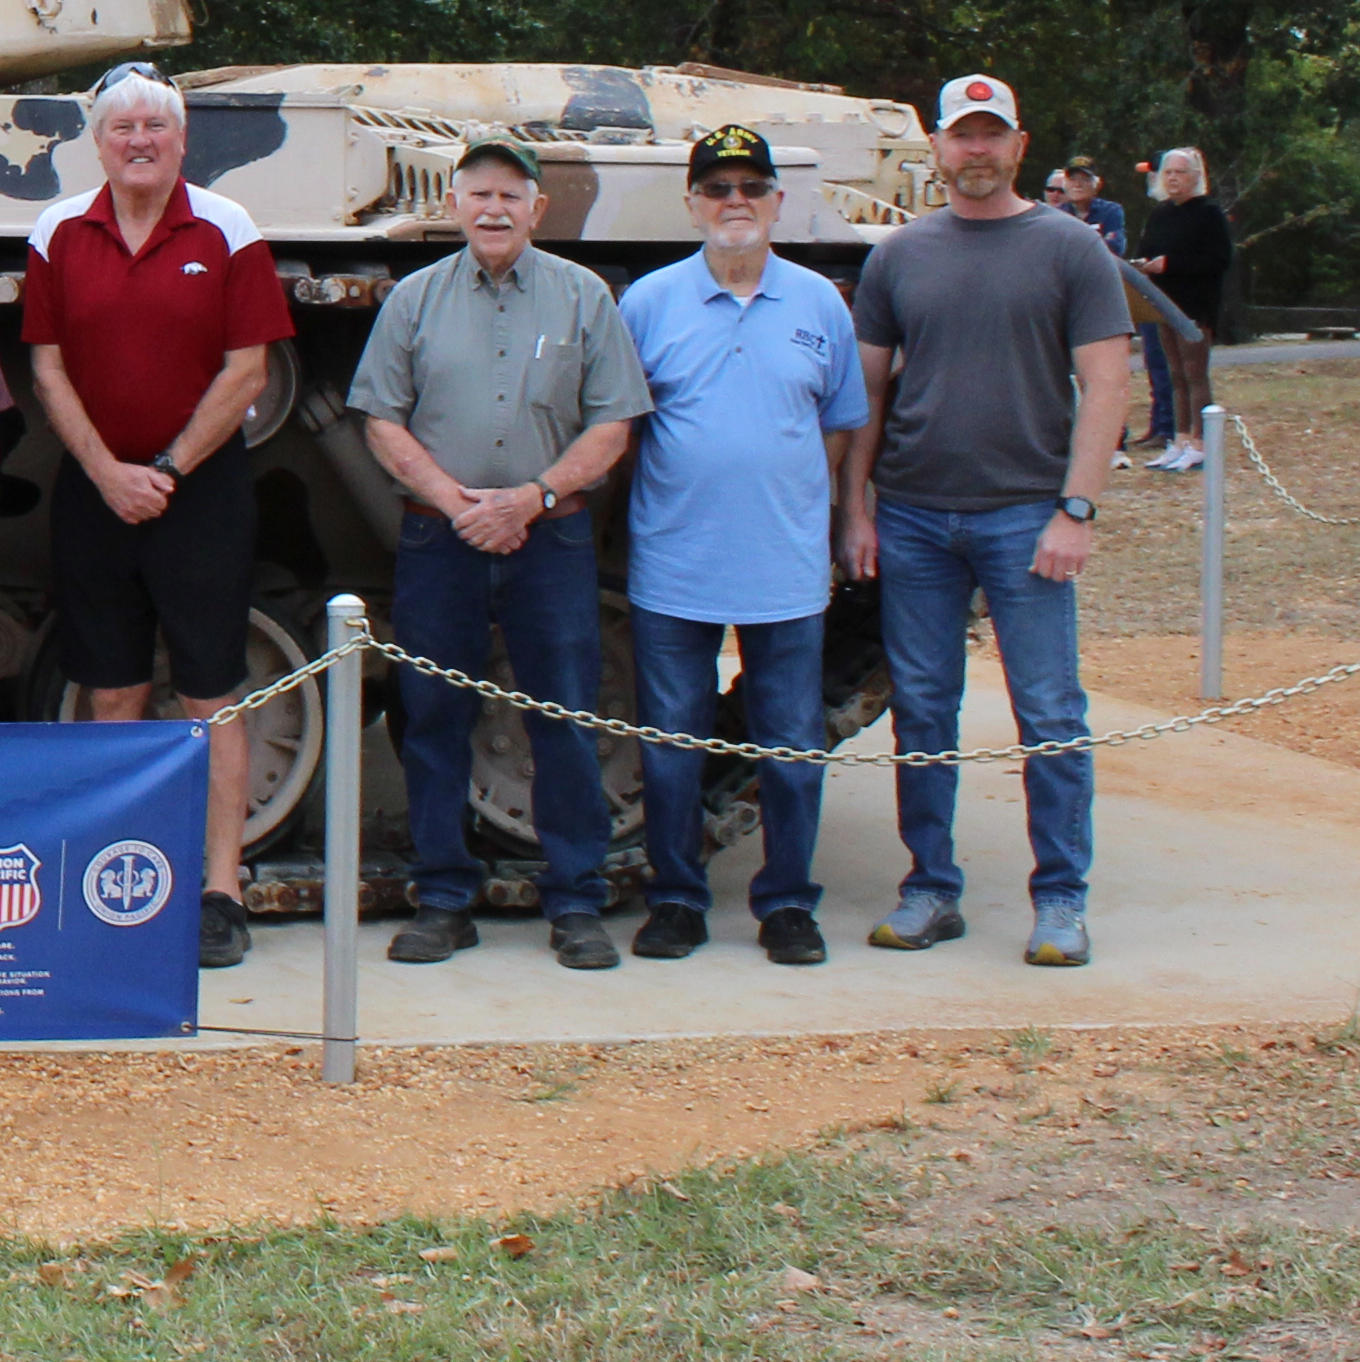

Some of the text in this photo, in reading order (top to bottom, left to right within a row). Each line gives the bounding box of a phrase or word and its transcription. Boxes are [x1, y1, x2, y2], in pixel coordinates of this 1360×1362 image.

[729, 127, 758, 144] ARMY
[716, 148, 752, 157] VETERAN
[9, 970, 51, 979] SITUATION
[21, 988, 45, 996] FROM
